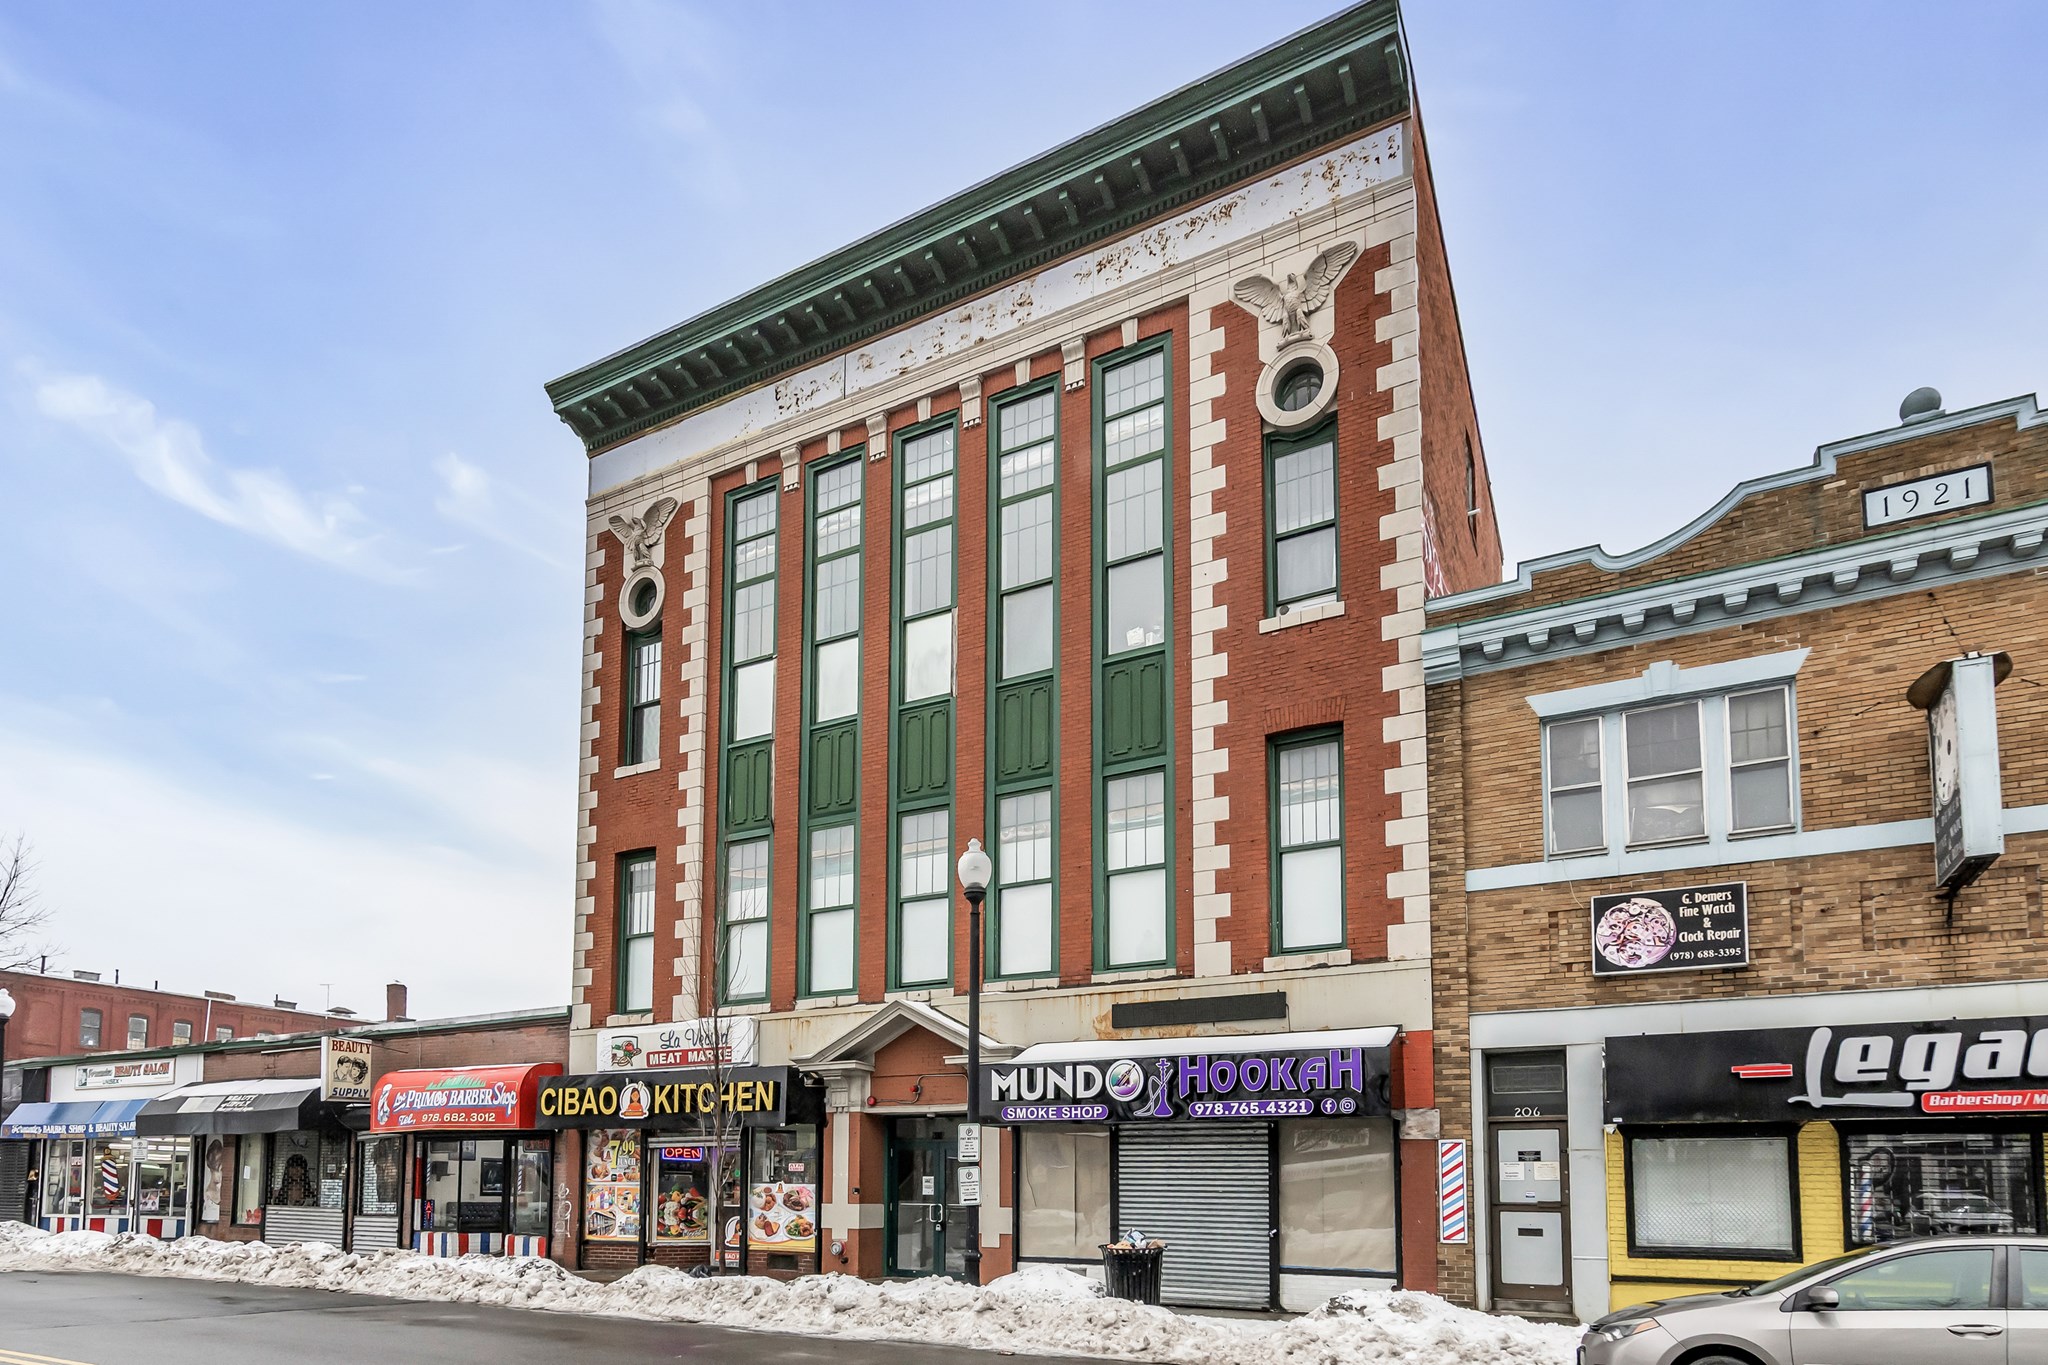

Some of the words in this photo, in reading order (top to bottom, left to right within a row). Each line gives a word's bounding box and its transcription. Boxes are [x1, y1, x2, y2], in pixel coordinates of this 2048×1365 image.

[1884, 477, 1978, 517] 1921
[1682, 893, 1692, 904] G.
[1695, 891, 1732, 903] Demers
[1679, 906, 1699, 917] Fine
[1702, 902, 1735, 915] Watch
[1703, 917, 1712, 928] &
[1679, 931, 1704, 942] Clock
[1707, 928, 1742, 941] Repair
[1670, 951, 1694, 961] (978)
[1698, 947, 1742, 959] 688-3395
[332, 1040, 372, 1054] BEAUTY
[650, 1052, 682, 1065] MEAT
[114, 1064, 142, 1077] BEAUTY
[143, 1062, 170, 1075] SALON
[991, 1059, 1145, 1101] MUNDO
[332, 1087, 369, 1097] SUPPLY
[448, 1088, 493, 1106] BARBER
[493, 1081, 518, 1115] Shop
[541, 1086, 617, 1115] CIBAO
[654, 1080, 775, 1114] KITCHEN
[1929, 1094, 2023, 1106] Barbershop
[1007, 1107, 1057, 1118] SMOKE
[1061, 1106, 1103, 1118] SHOP
[1194, 1101, 1308, 1115] 978.765.4321
[1514, 1107, 1541, 1118] 206
[43, 1125, 66, 1134] BARBER
[68, 1124, 85, 1133] SHOP
[95, 1122, 118, 1132] BEAUTY
[665, 1147, 700, 1158] OPEN
